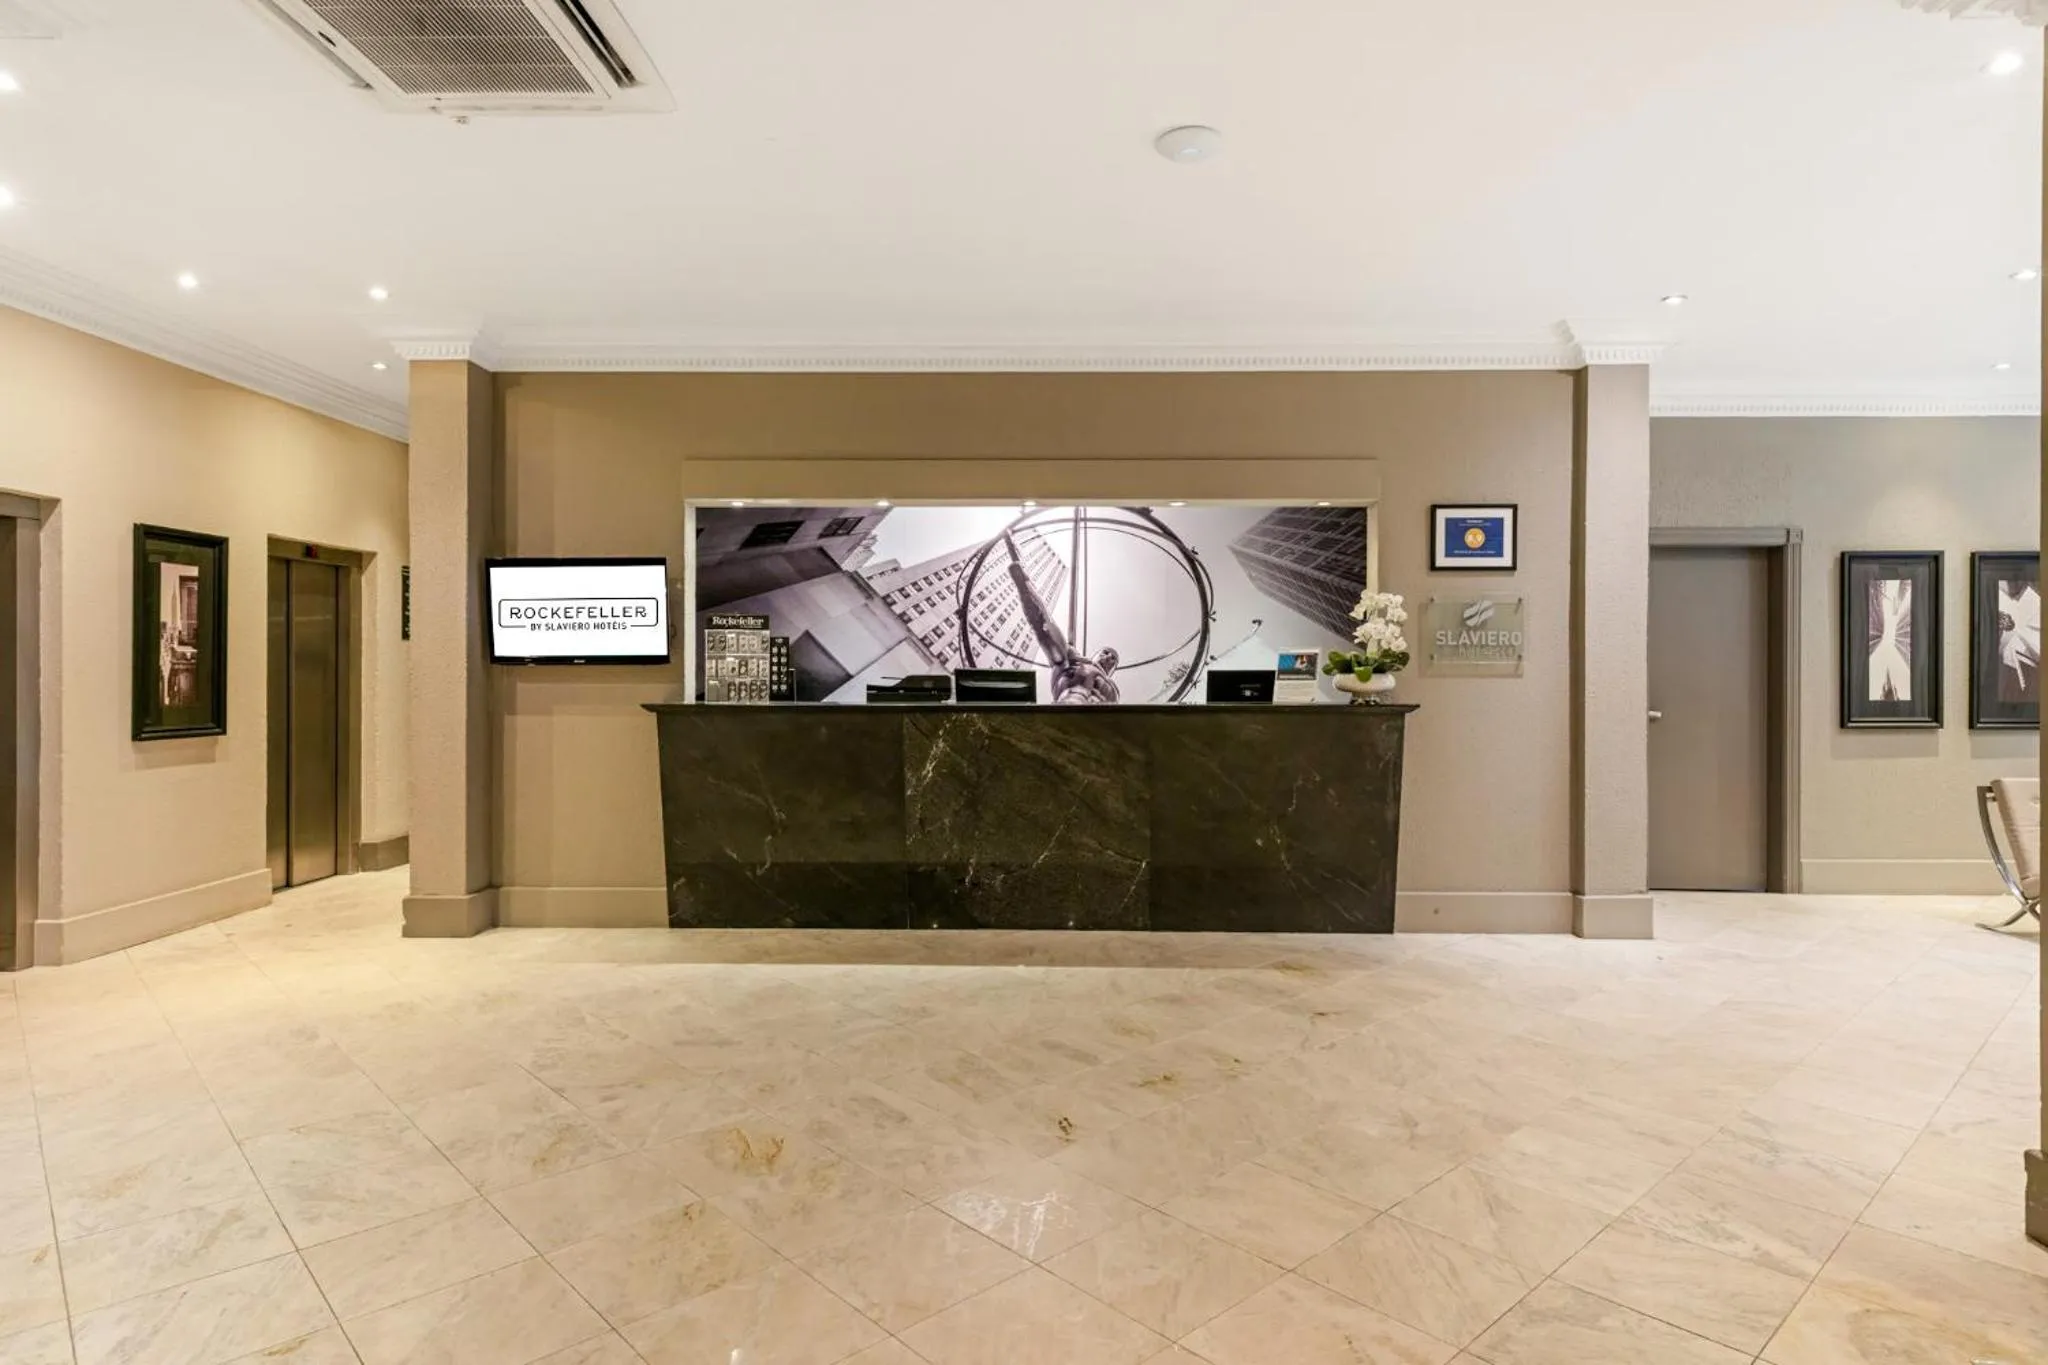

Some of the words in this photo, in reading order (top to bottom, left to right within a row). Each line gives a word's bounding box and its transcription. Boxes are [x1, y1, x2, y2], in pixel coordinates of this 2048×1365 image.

[509, 606, 647, 619] ROCKEFELLER
[530, 623, 542, 631] BY
[545, 622, 591, 631] SLAVIERO
[712, 616, 764, 627] Rockefeller
[1435, 630, 1522, 645] SLAVIERO
